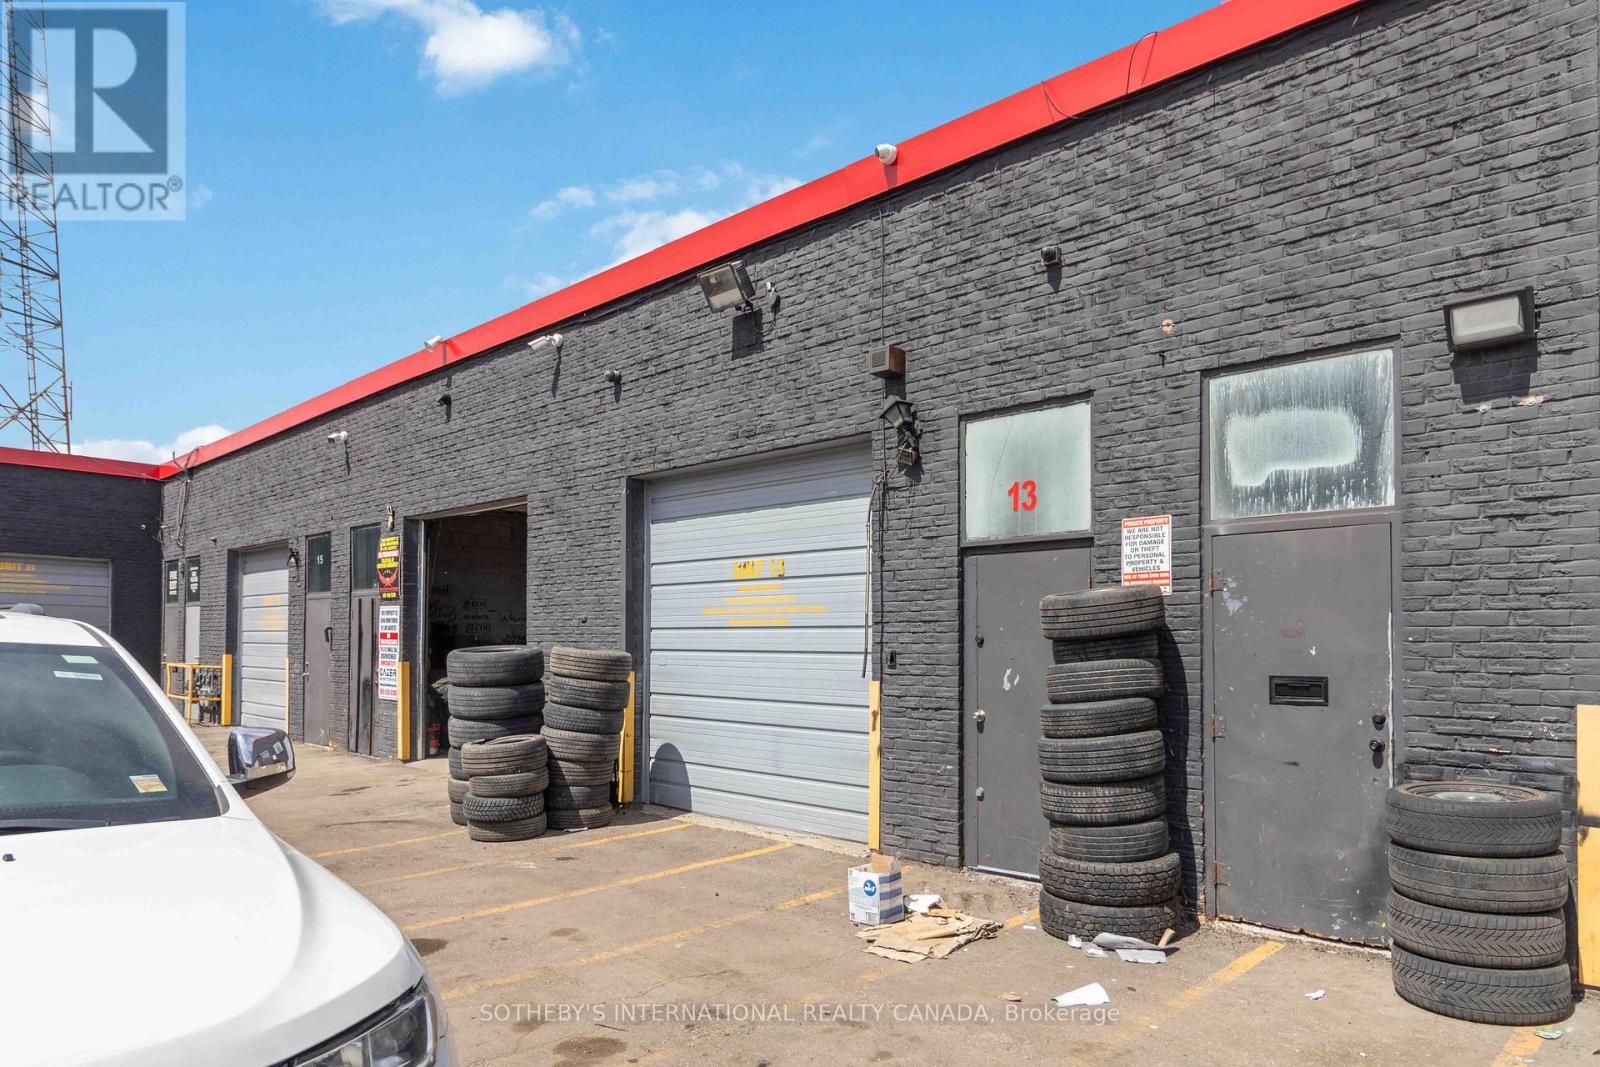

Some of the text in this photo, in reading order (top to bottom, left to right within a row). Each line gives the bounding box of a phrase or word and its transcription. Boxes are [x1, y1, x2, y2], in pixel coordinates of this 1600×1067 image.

[1007, 480, 1038, 512] 13
[1125, 532, 1166, 540] RESPONSIBLE
[317, 555, 324, 565] 15
